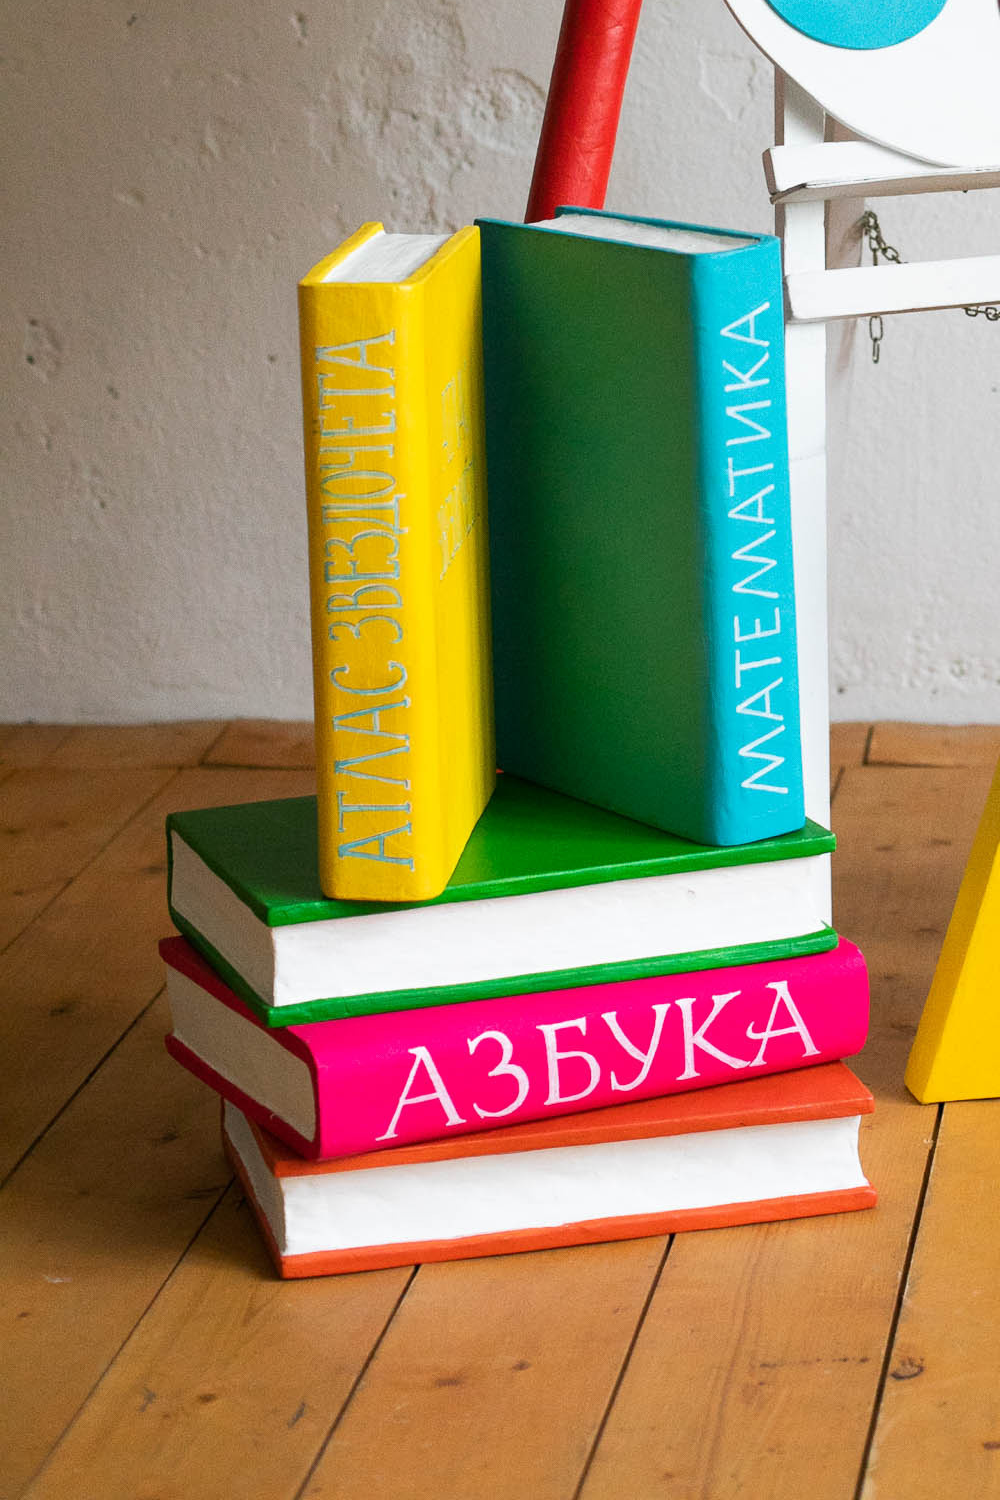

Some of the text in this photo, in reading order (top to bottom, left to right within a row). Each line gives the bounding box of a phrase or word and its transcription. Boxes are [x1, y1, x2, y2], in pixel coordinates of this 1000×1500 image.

[720, 301, 788, 794] МАТЕМАТИКА
[331, 660, 416, 873] АТЛАС
[375, 980, 821, 1142] АЗБУКА
